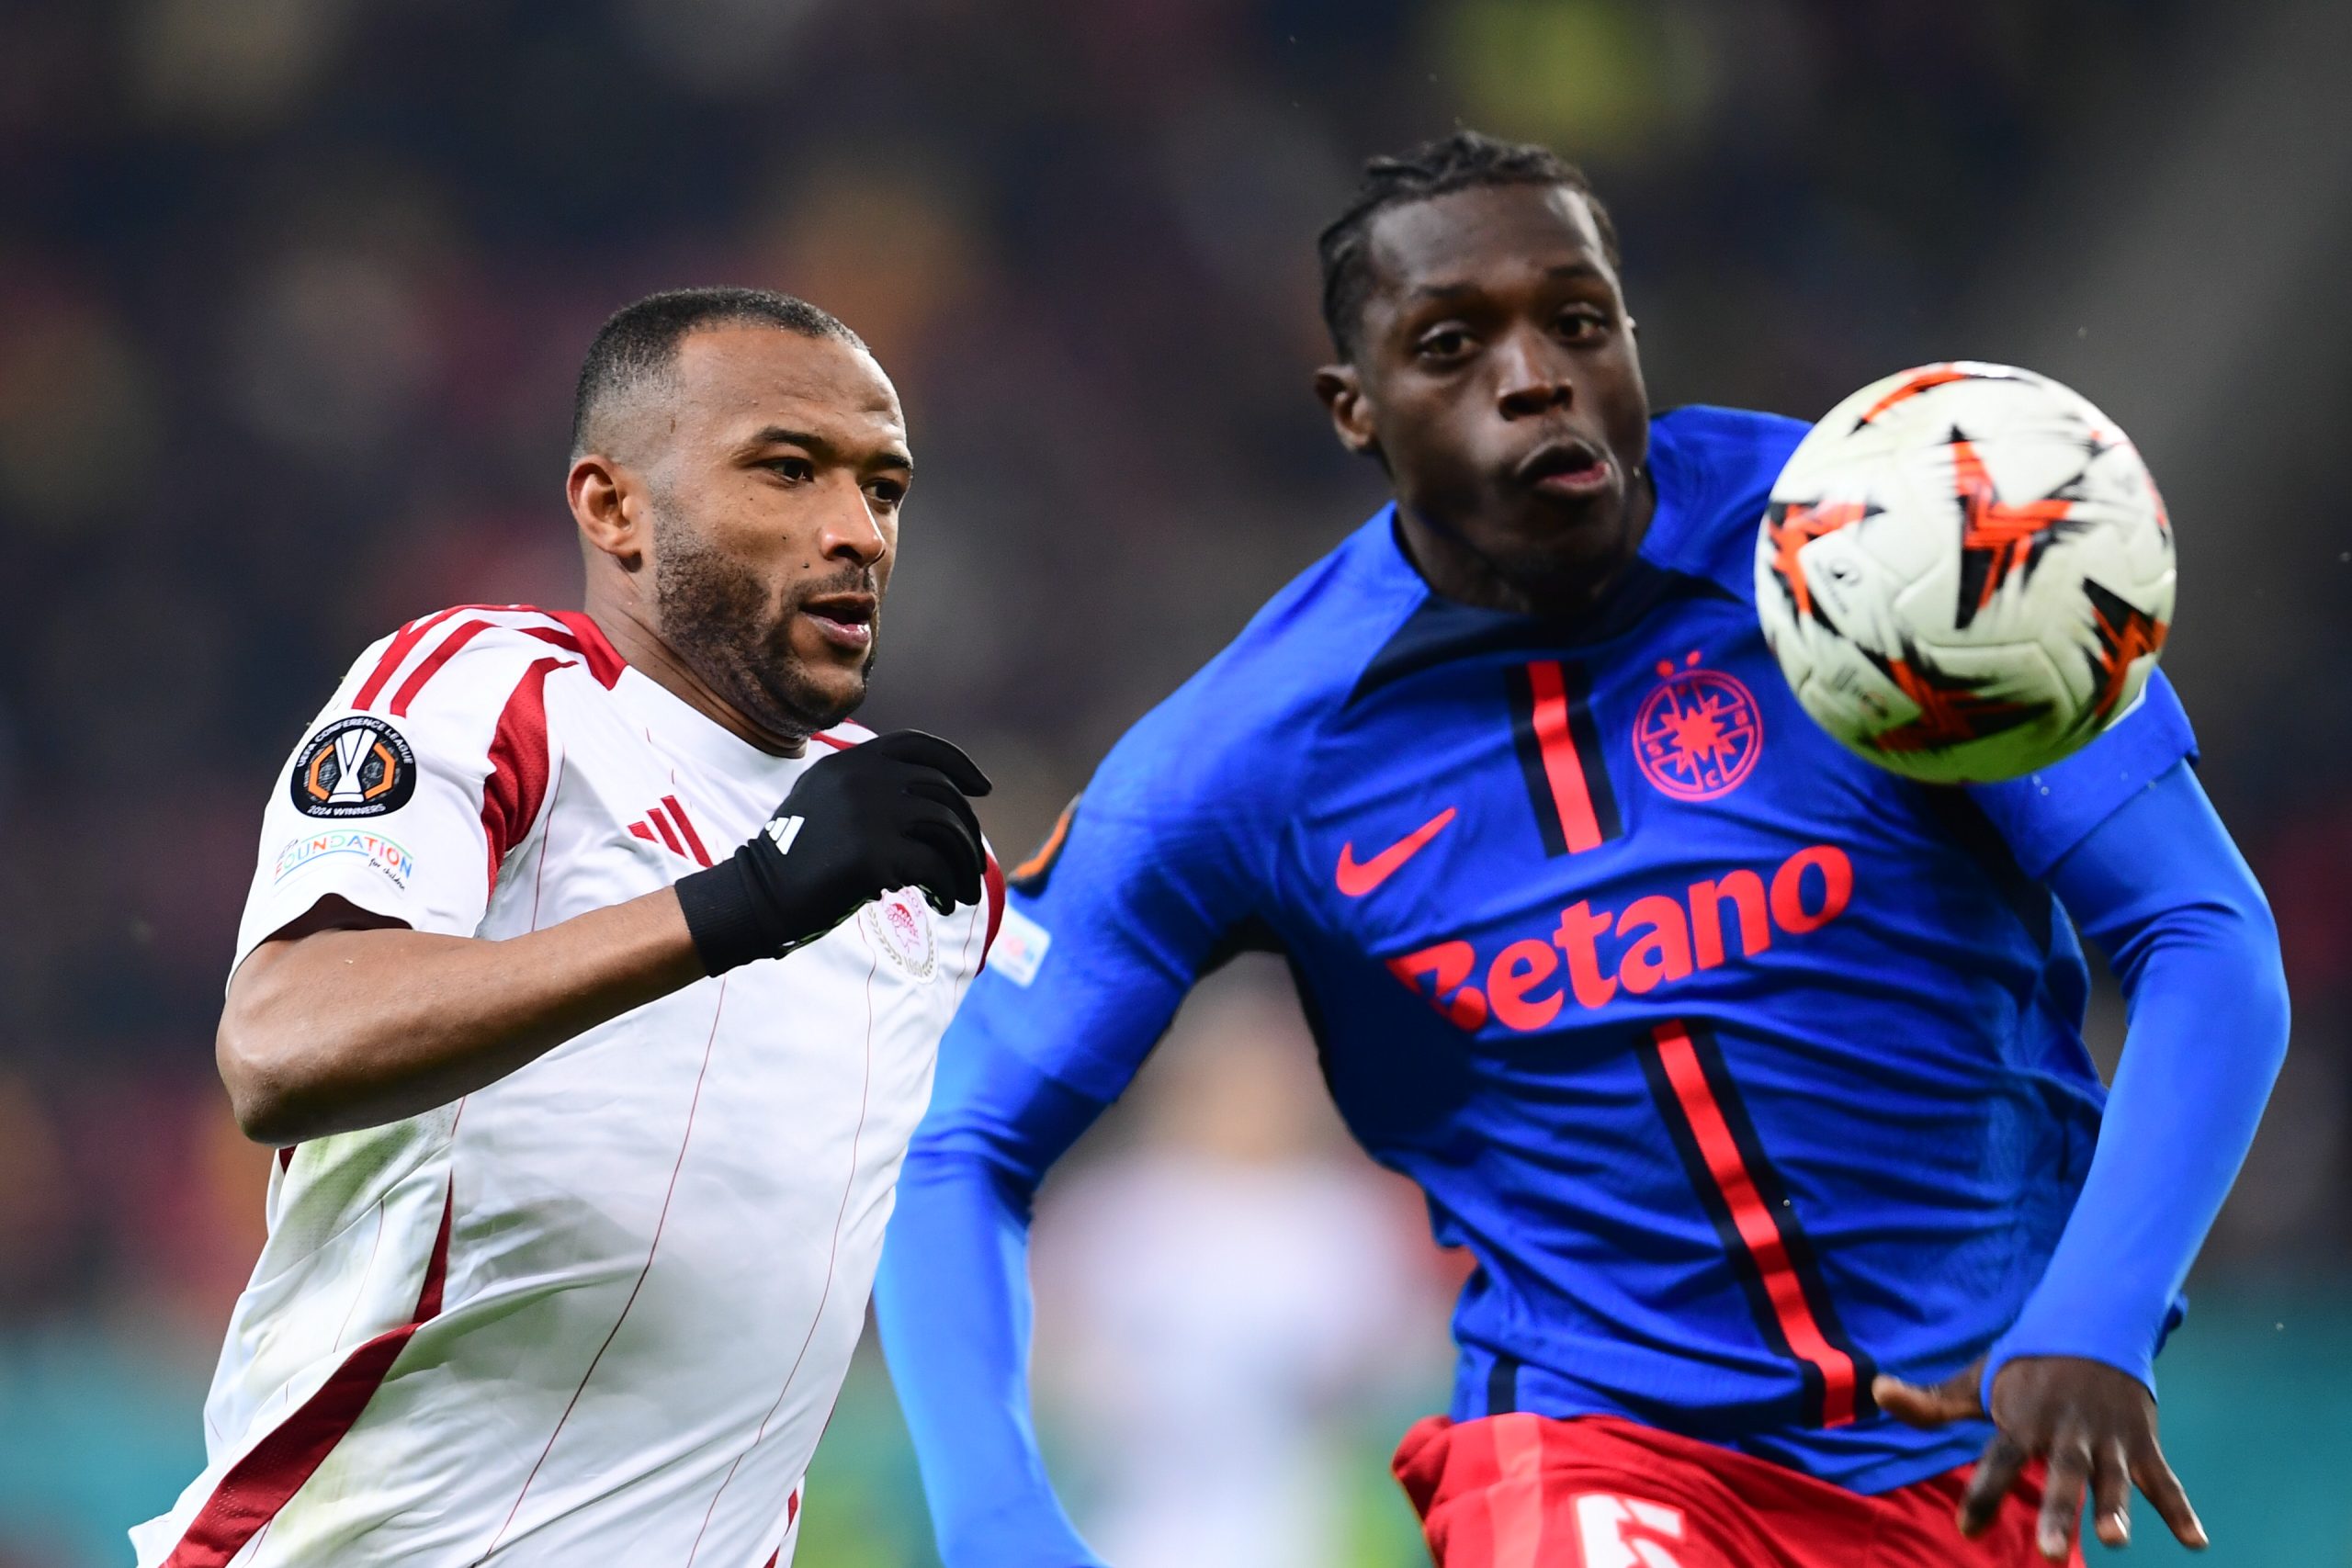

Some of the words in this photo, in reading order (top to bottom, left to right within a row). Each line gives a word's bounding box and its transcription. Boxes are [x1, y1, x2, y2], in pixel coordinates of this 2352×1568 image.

[297, 743, 318, 767] UEFA
[314, 717, 386, 742] CONFERENCE
[384, 728, 413, 764] LEAGUE
[307, 805, 333, 816] 2024
[334, 804, 386, 816] WINNERS
[275, 835, 412, 878] FOUNDATION
